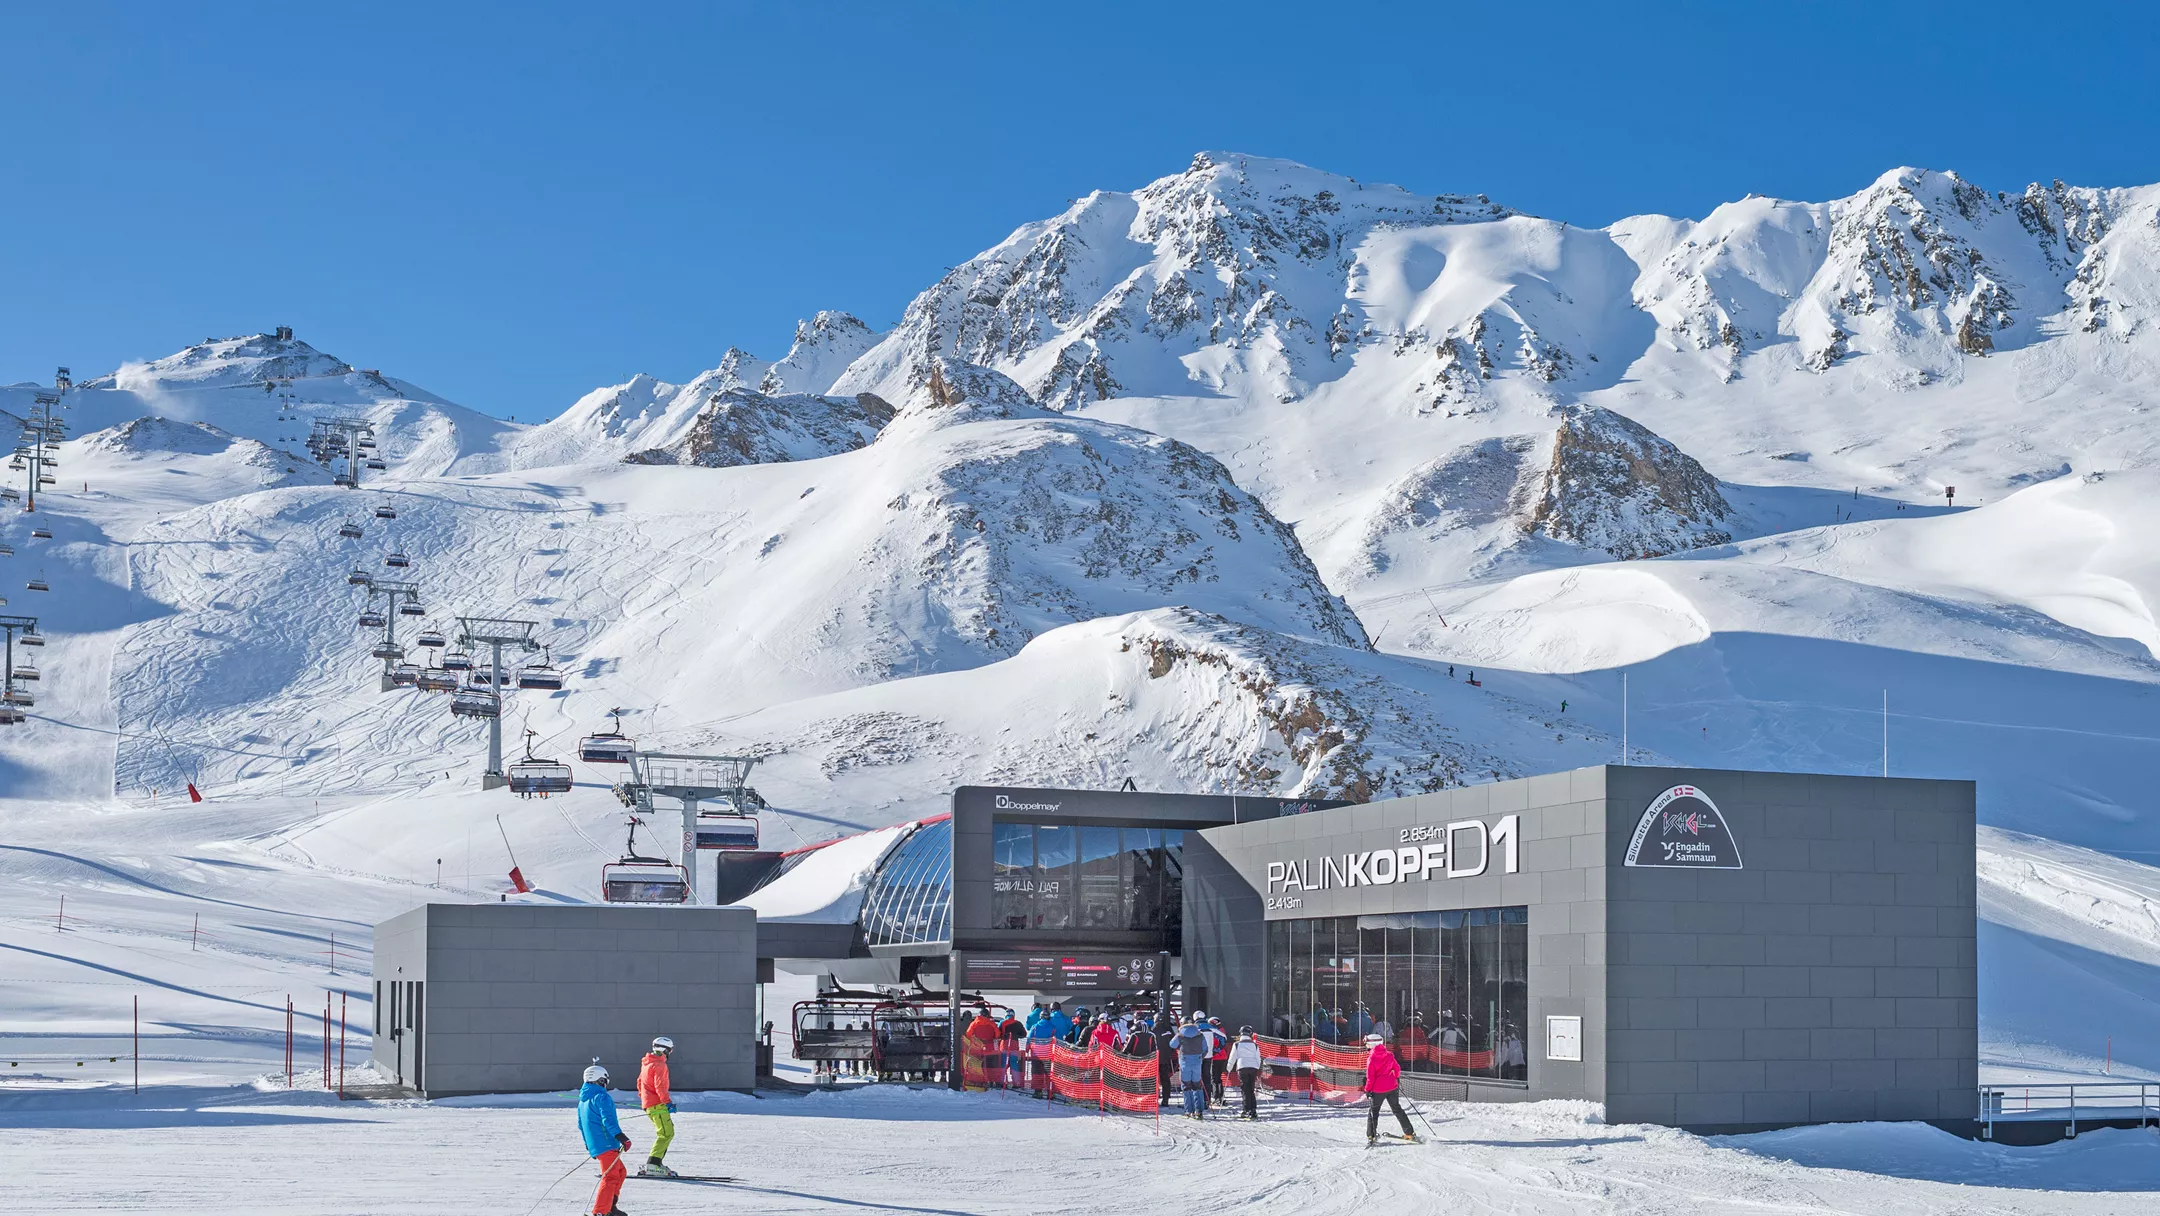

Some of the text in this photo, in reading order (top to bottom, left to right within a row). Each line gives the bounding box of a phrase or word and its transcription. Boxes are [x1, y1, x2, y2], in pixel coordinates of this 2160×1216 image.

[1008, 801, 1060, 812] Doppelmayr
[1400, 825, 1447, 843] 2.854m
[1628, 794, 1672, 862] Silvretta Arena
[1267, 814, 1520, 894] PALINKOPF D1
[1675, 842, 1711, 853] Engadin
[1675, 852, 1717, 862] Samnaun
[1267, 896, 1303, 910] 2.413m
